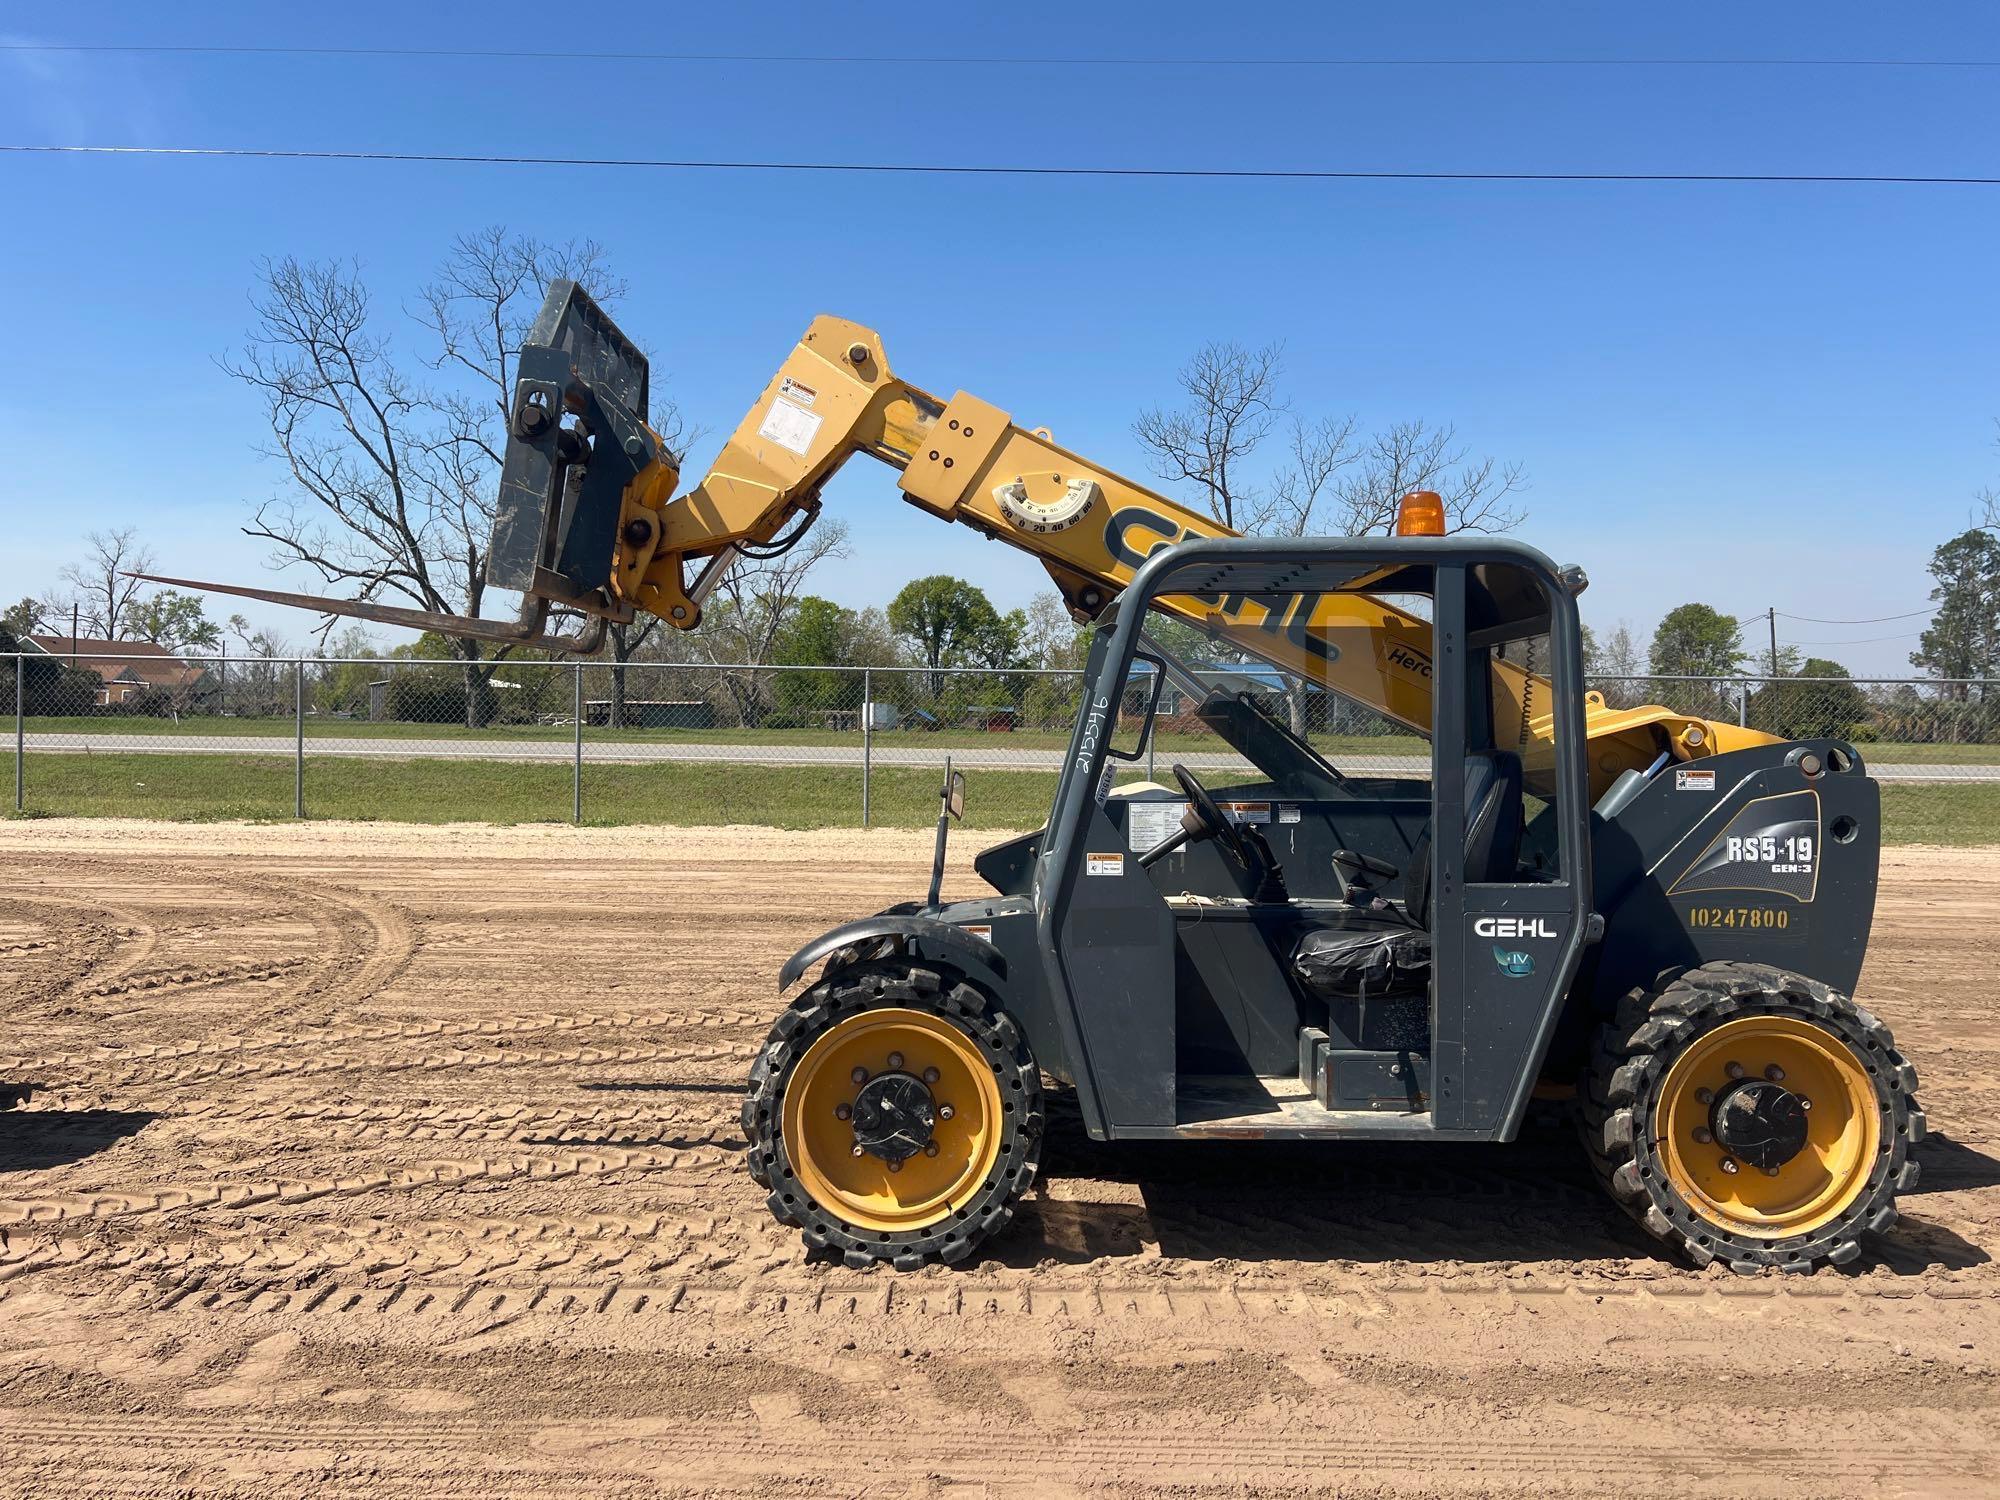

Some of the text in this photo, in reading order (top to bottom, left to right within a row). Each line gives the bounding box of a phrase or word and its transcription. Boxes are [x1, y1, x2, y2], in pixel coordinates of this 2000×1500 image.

[1001, 504, 1013, 519] -20
[1019, 518, 1025, 527] 0
[1033, 524, 1046, 532] 20
[1051, 523, 1064, 532] 40
[1068, 514, 1080, 526] 60
[1082, 501, 1092, 514] 80
[1388, 648, 1432, 679] Herc
[1076, 697, 1108, 773] 215546
[1098, 773, 1112, 803] 215546
[1727, 836, 1812, 862] RS5-19
[1474, 918, 1557, 937] GEHL
[1691, 908, 1788, 928] 10247800
